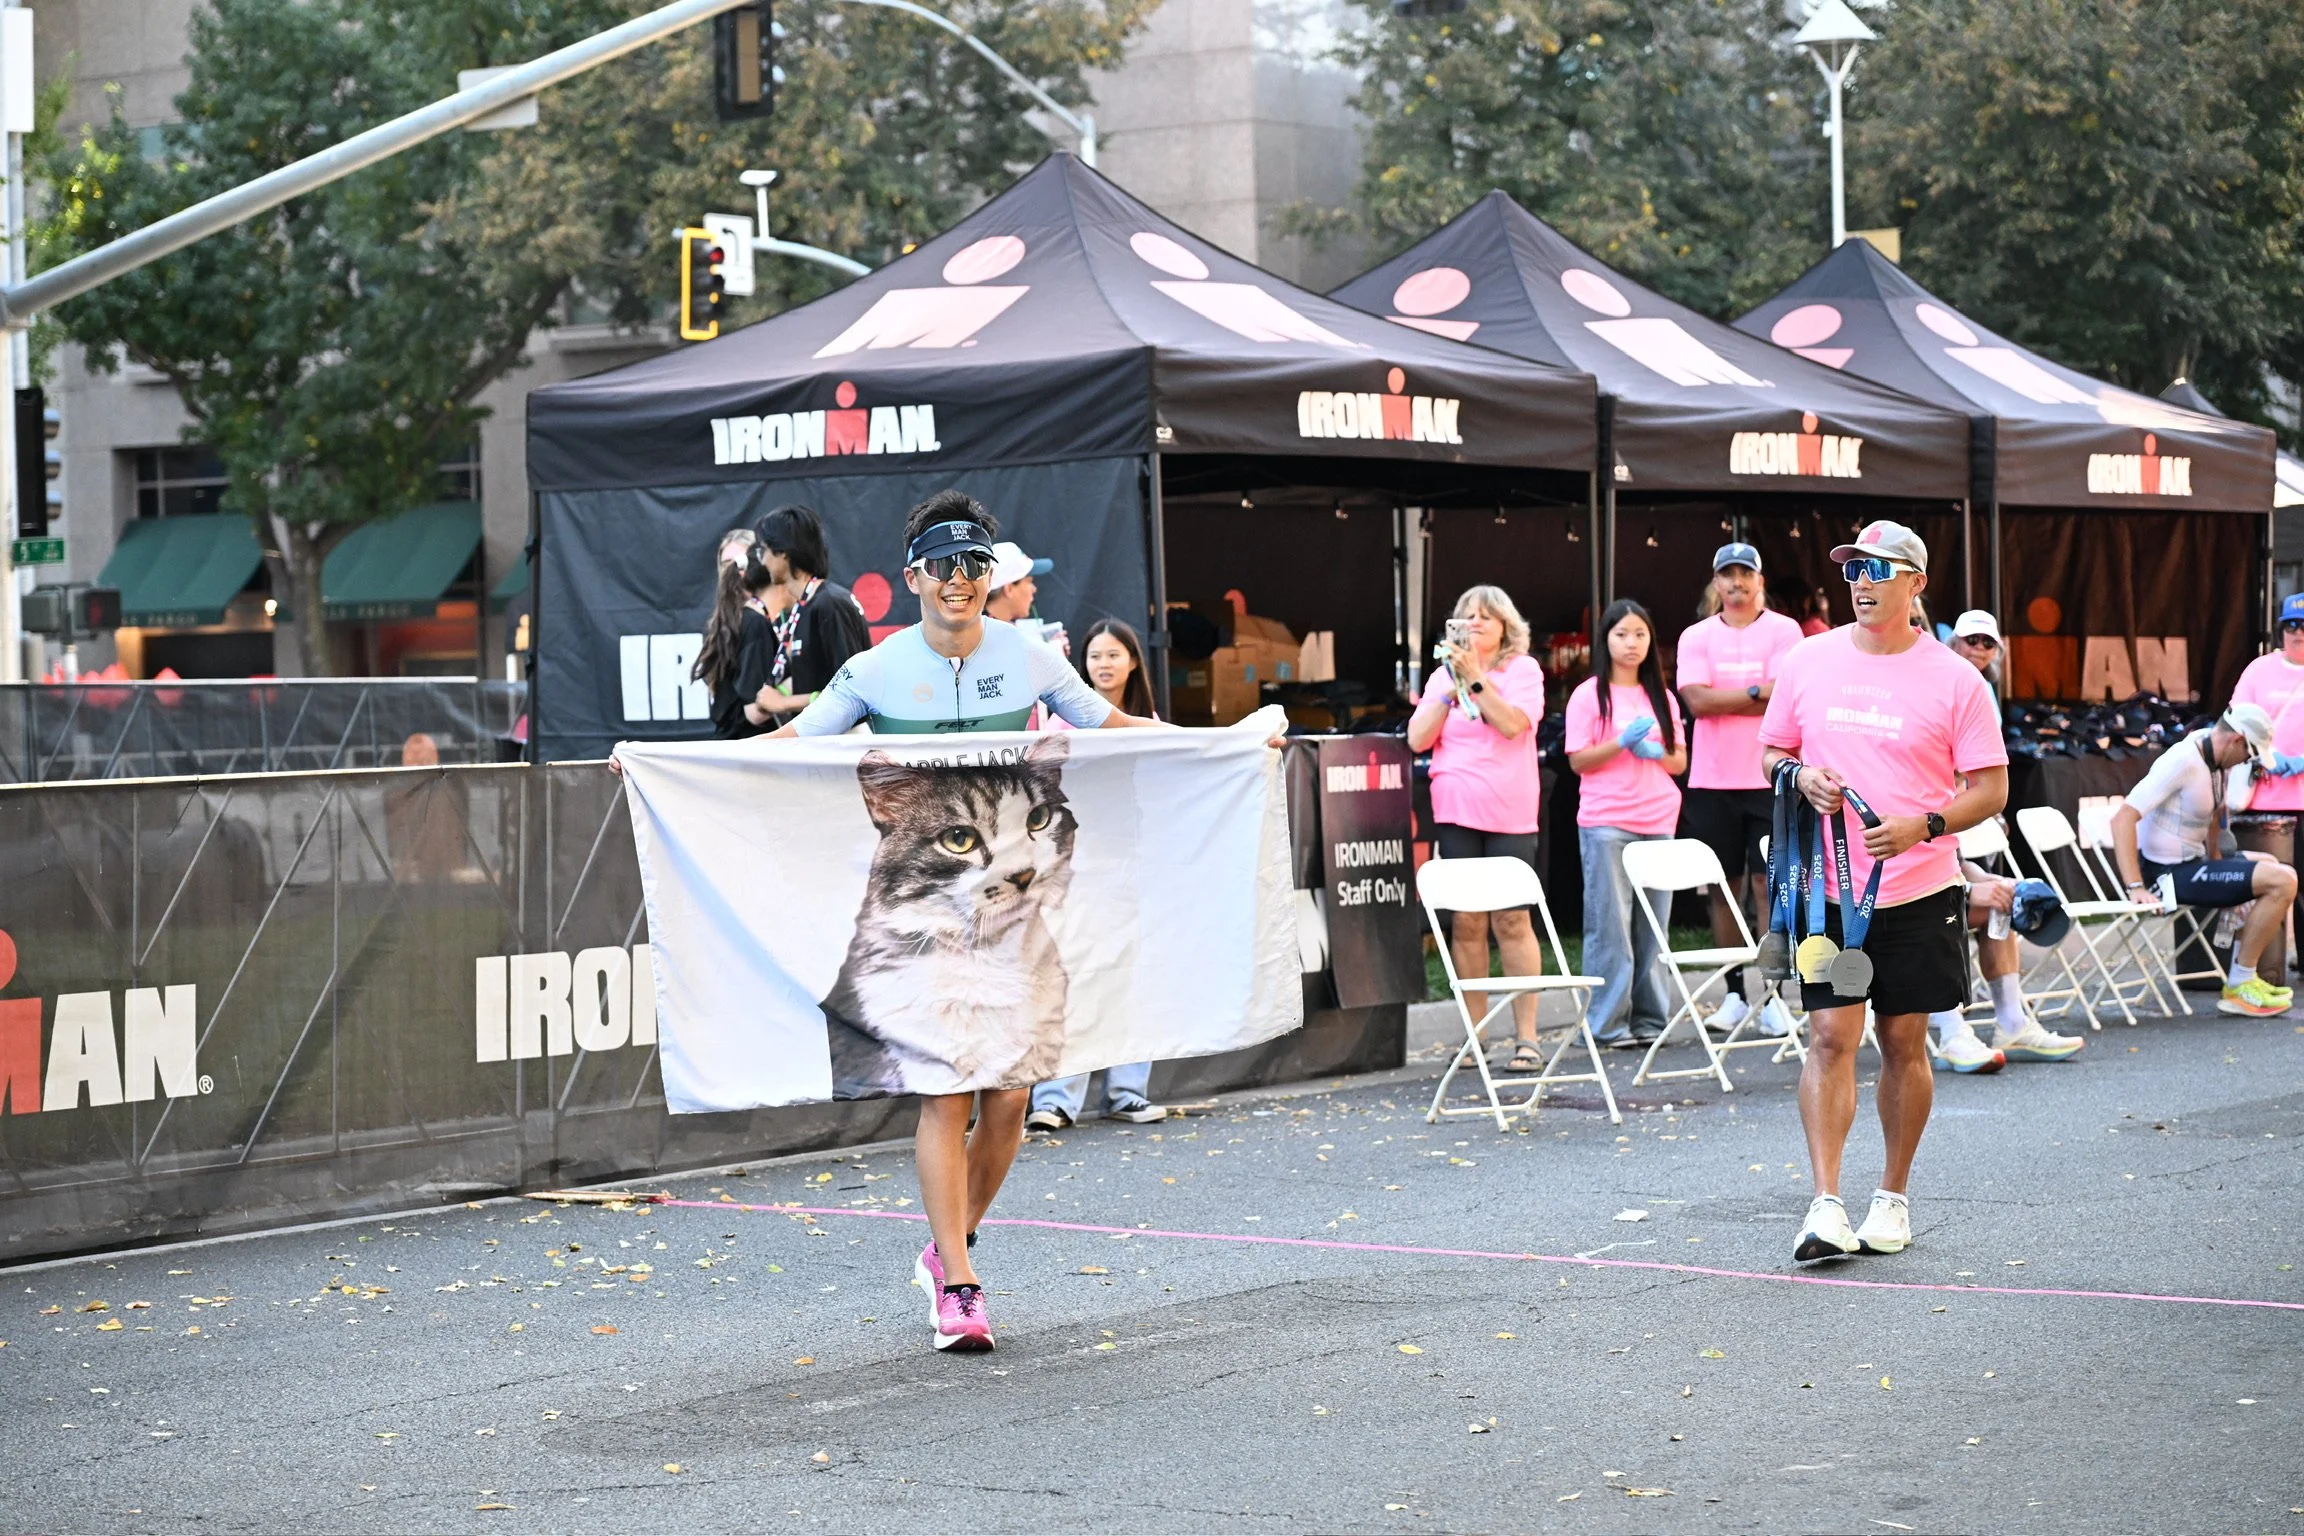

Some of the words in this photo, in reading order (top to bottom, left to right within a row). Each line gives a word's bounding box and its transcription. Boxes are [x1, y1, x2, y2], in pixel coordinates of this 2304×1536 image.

[1299, 367, 1462, 443] IRONMAN
[712, 381, 941, 465] IRONMAN
[1730, 411, 1863, 478] IRONMAN
[2087, 433, 2192, 496] IRONMAN
[976, 673, 1005, 687] EVERY
[978, 683, 998, 693] MAN
[979, 690, 1003, 700] JACK
[934, 719, 985, 729] FELT
[1825, 723, 1885, 737] CALIFORNIA
[1826, 705, 1904, 730] IRONMAN
[1326, 751, 1403, 793] IRONMAN
[1335, 839, 1404, 868] IRONMAN
[1836, 839, 1850, 890] FINISHER
[1789, 865, 1798, 890] 2025
[1813, 854, 1822, 880] 2025
[2209, 871, 2245, 884] surpas
[1337, 878, 1372, 906] Staff
[1375, 876, 1406, 907] Only
[1779, 883, 1789, 908] 2025
[1860, 893, 1874, 919] 2025
